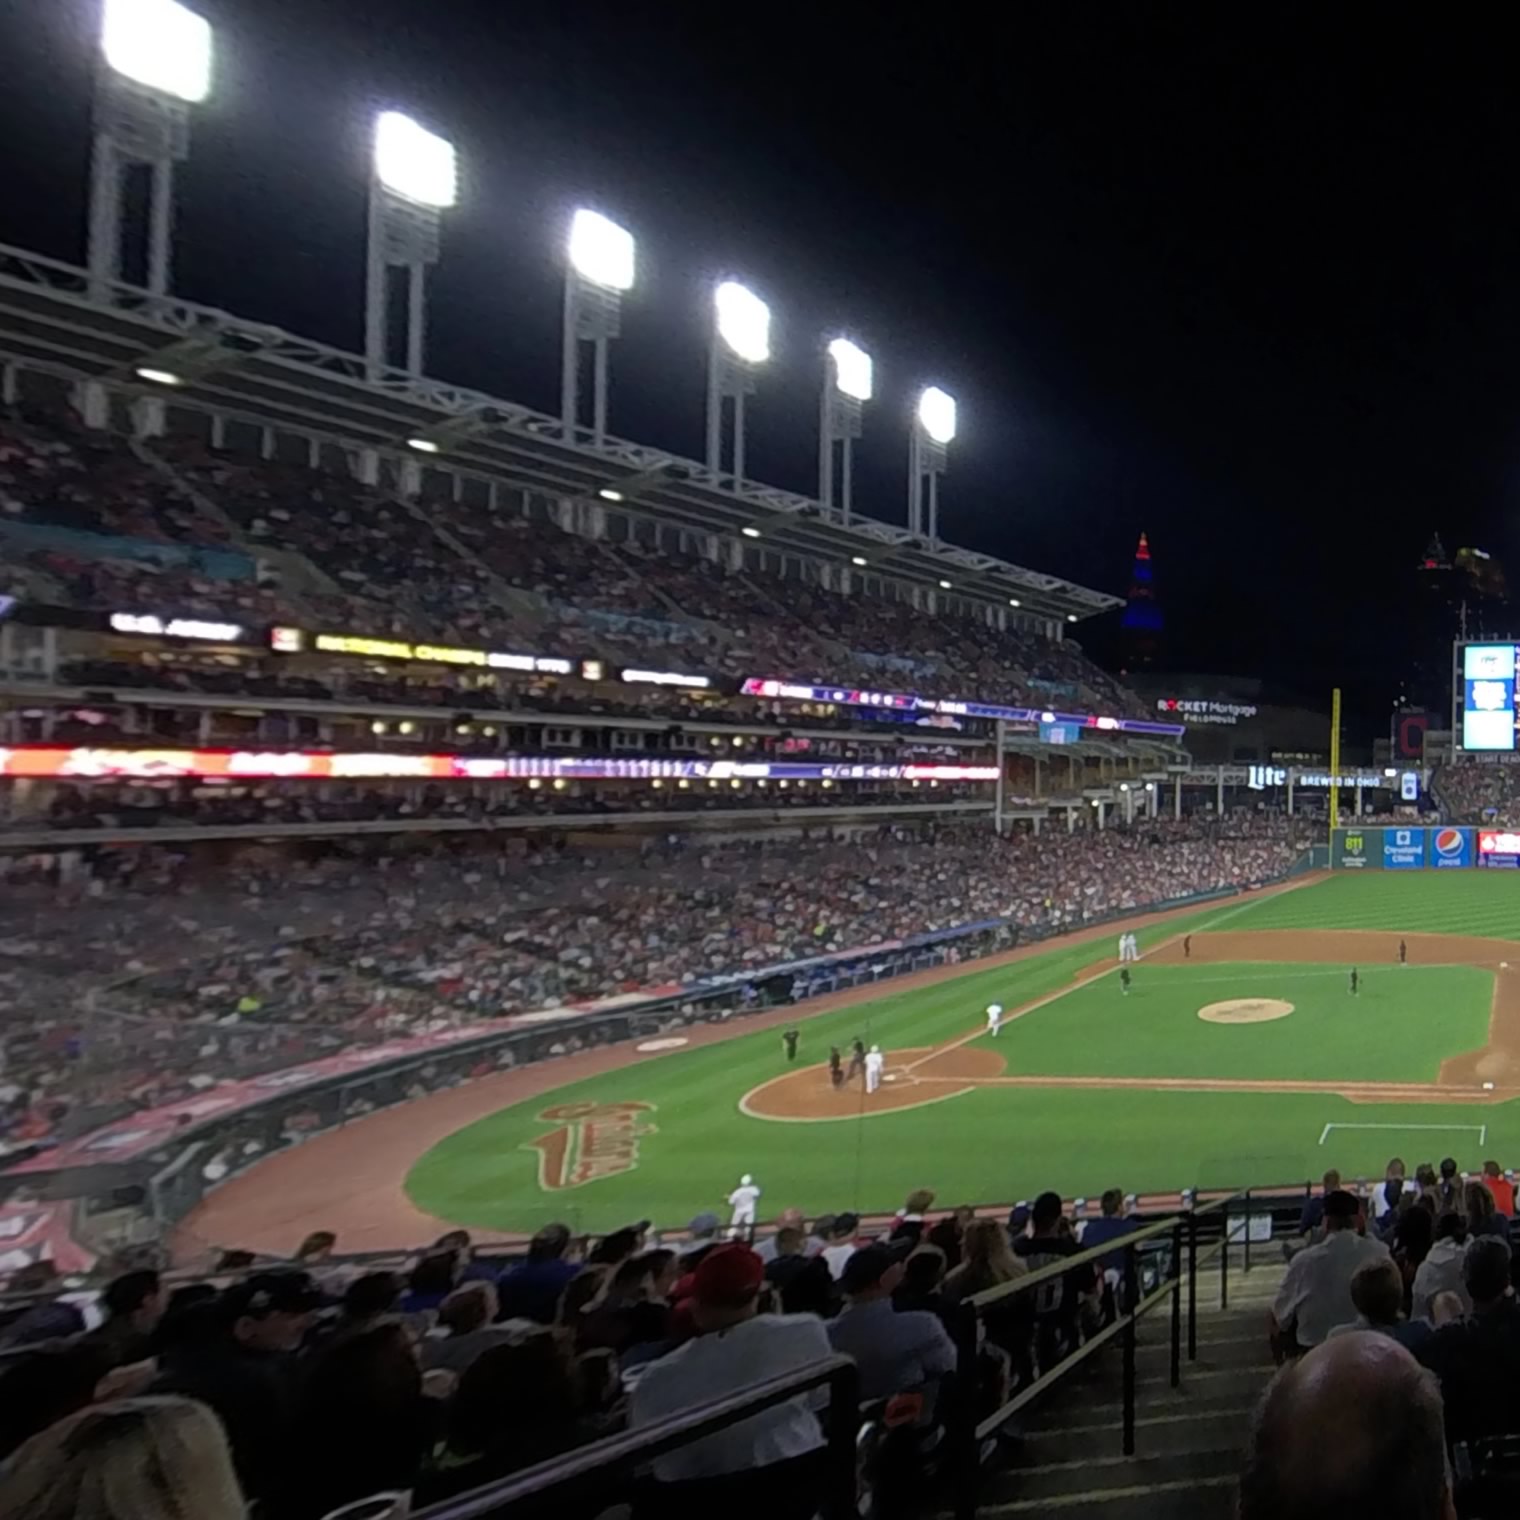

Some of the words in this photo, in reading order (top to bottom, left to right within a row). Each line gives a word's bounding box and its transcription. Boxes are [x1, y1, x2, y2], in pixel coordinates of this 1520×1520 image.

[1157, 699, 1208, 713] ROCKET
[1209, 701, 1257, 717] Mortgage
[1248, 765, 1286, 790] Lite
